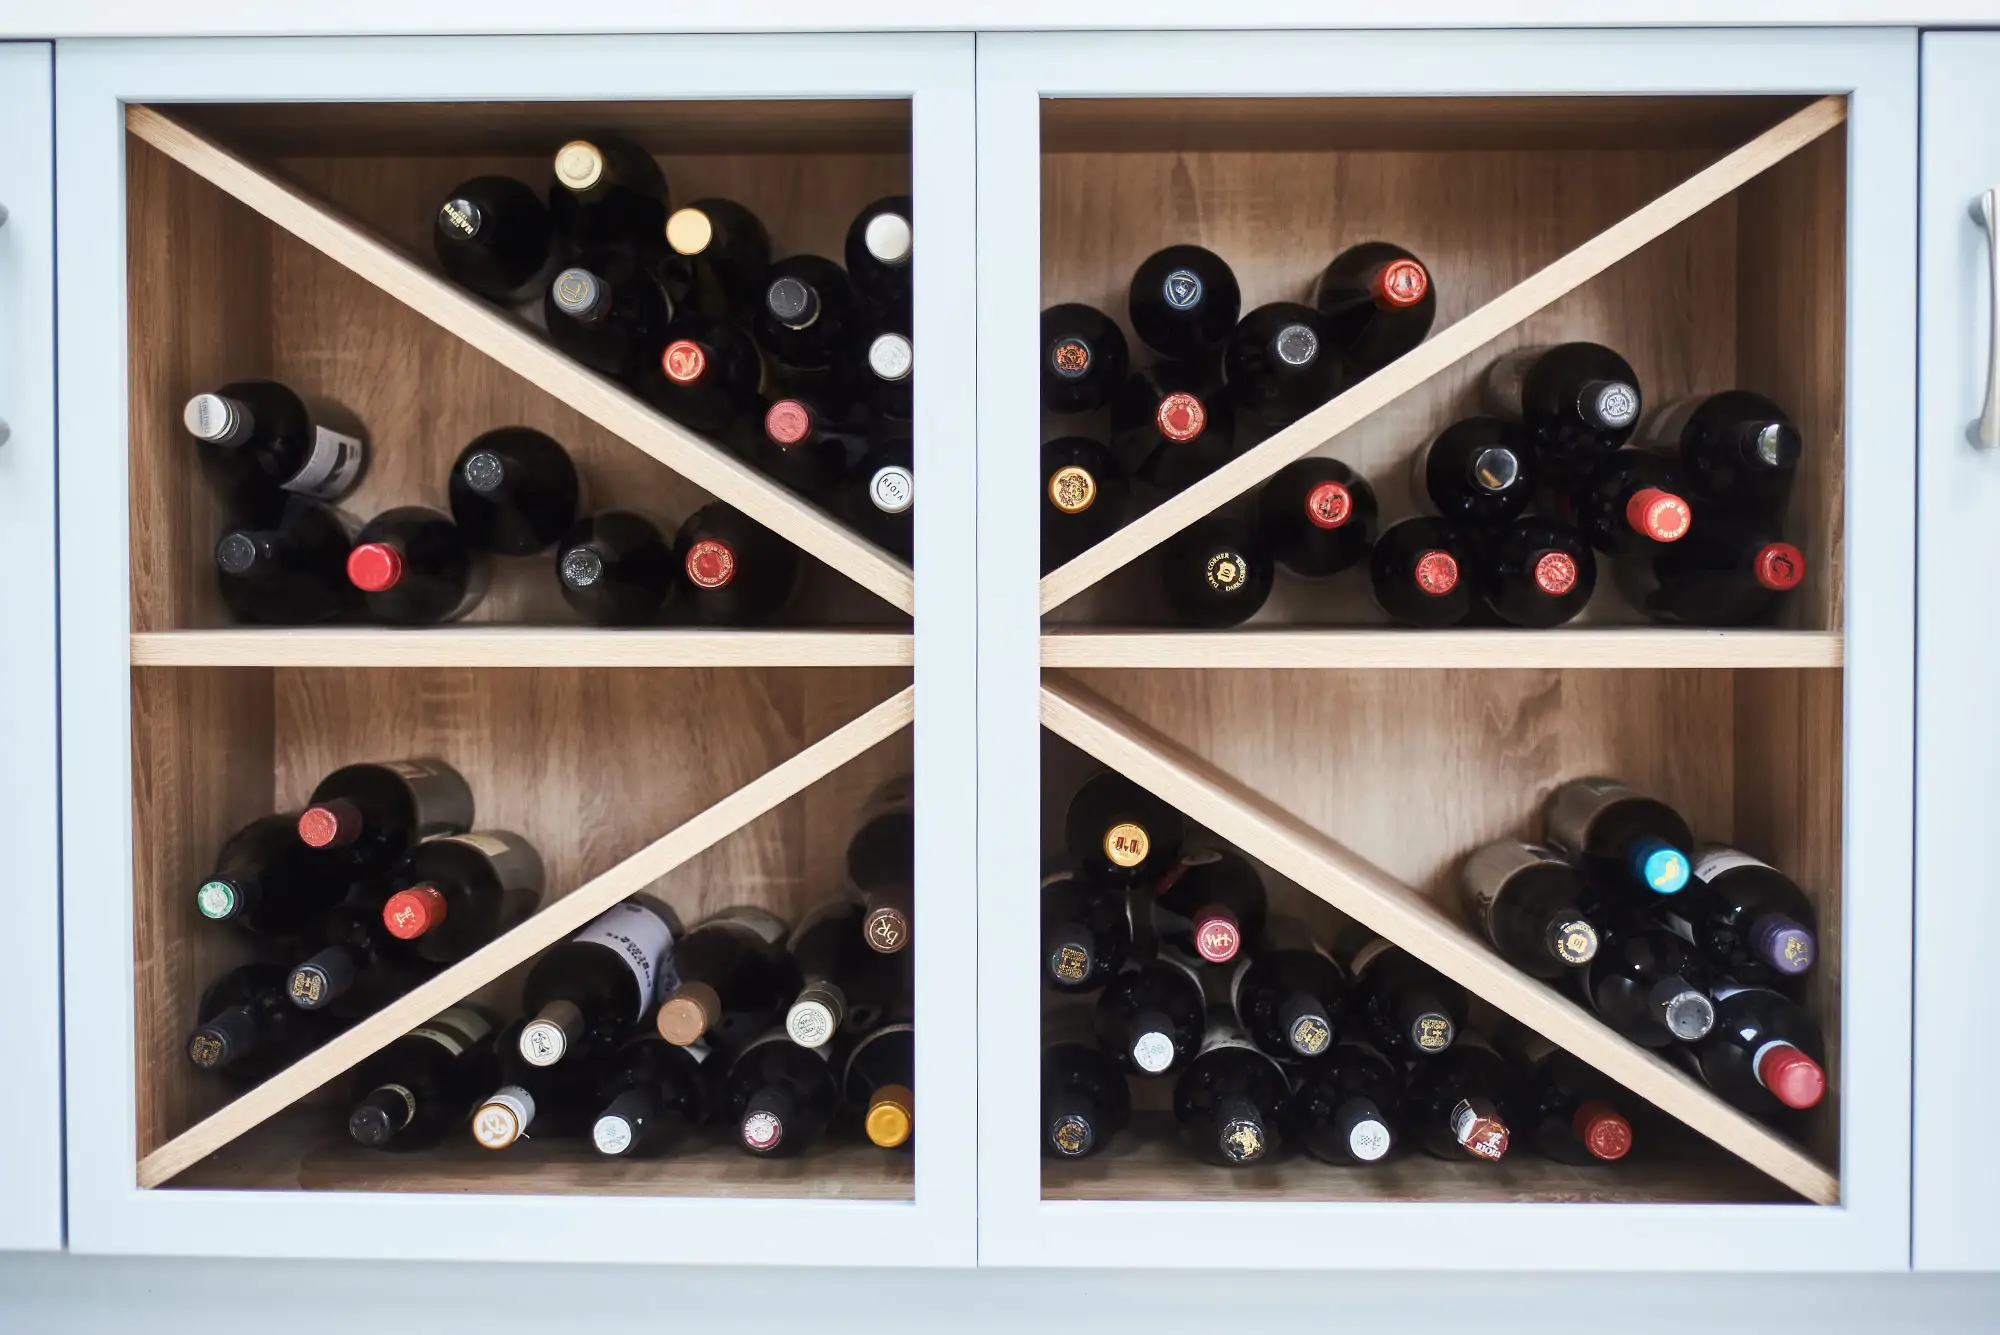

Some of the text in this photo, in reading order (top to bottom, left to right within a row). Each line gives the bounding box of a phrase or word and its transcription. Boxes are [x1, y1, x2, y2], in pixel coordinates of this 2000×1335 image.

[882, 478, 904, 501] RIOJA
[1207, 552, 1229, 588] DARK CORNER
[1225, 581, 1241, 591] DARK
[876, 919, 898, 946] BR
